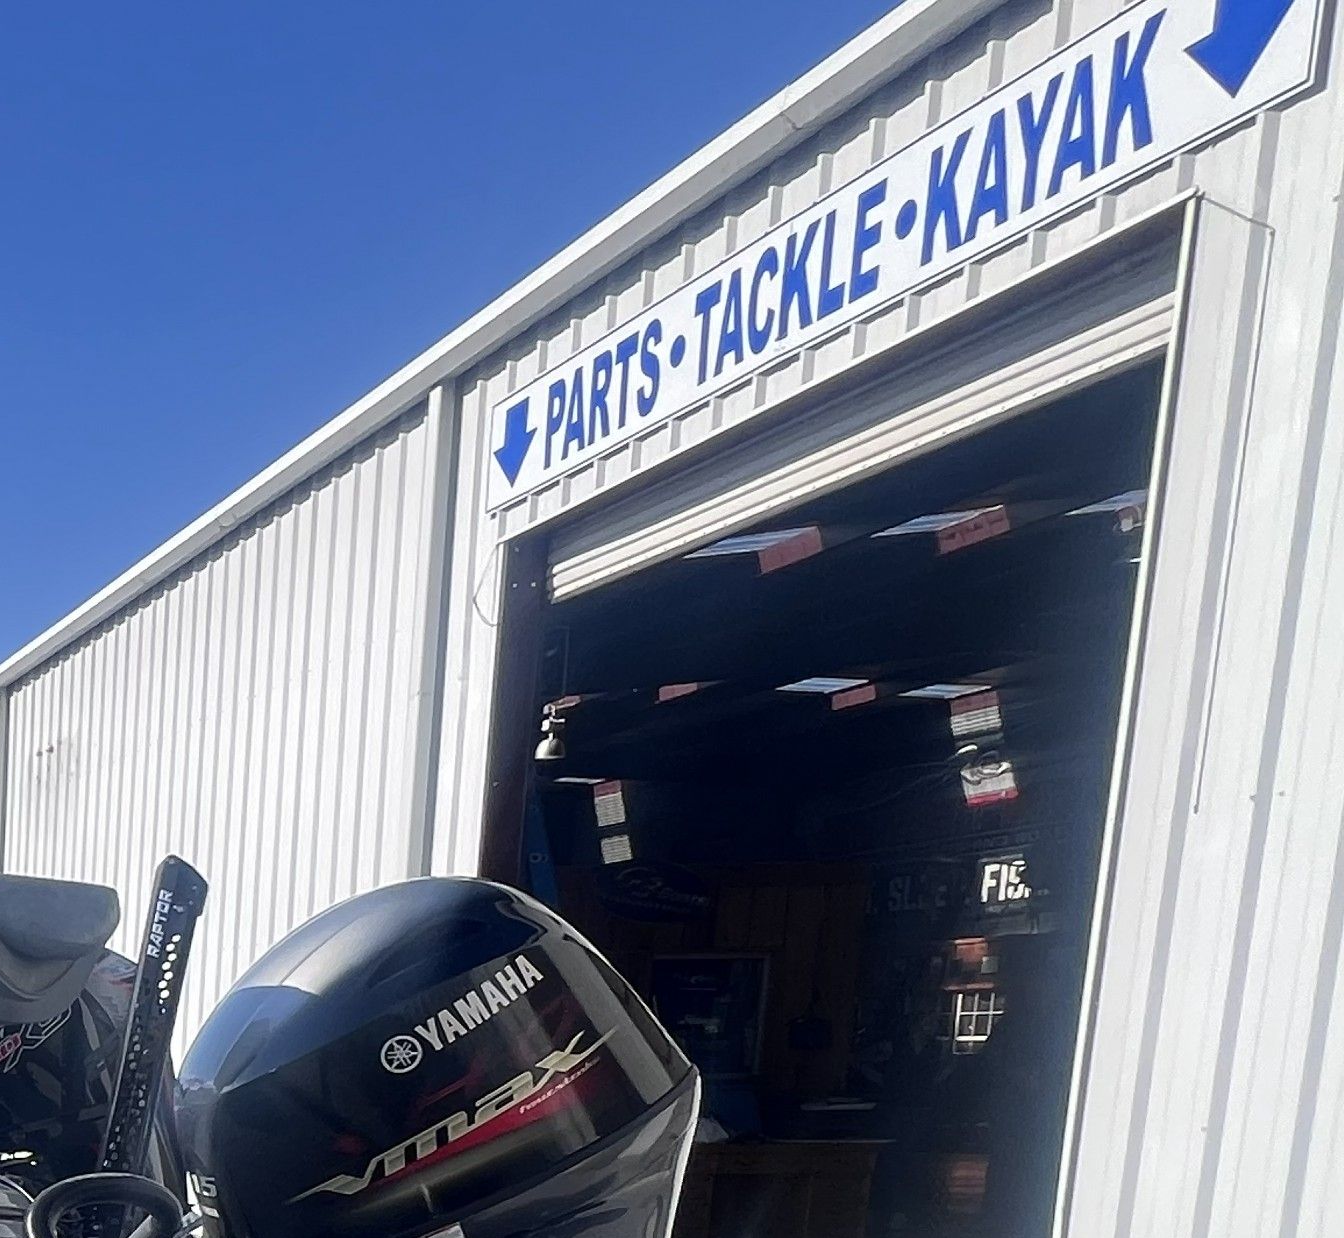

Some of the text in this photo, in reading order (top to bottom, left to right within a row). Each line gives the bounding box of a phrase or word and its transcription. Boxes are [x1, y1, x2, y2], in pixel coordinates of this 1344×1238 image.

[542, 9, 1168, 470] PARTS TACKLE KAYAK
[146, 888, 174, 959] RAPTOR
[414, 953, 544, 1053] YAMAHA
